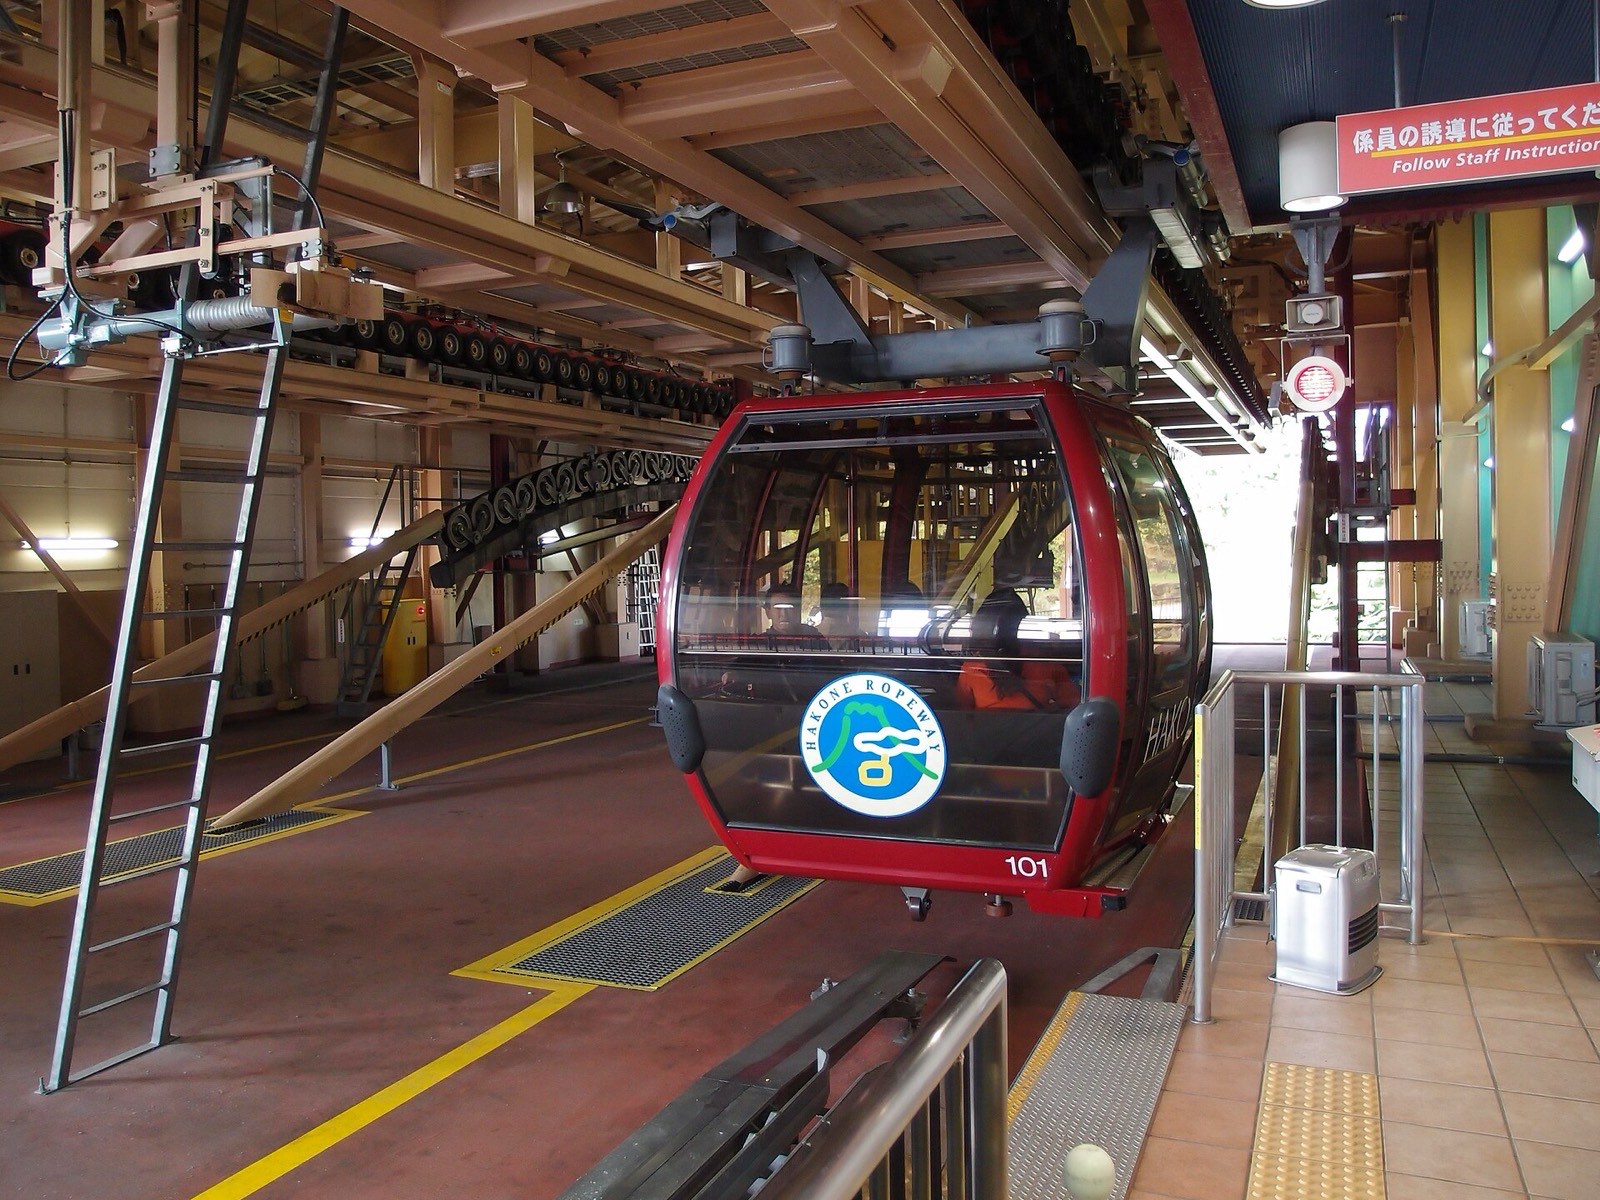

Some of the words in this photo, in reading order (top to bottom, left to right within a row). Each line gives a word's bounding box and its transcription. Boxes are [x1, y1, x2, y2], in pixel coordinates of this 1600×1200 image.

[1352, 101, 1600, 154] 係員の誘導に従ってくだ
[1392, 157, 1451, 173] Follow
[1456, 148, 1501, 166] Staff
[805, 681, 853, 751] HAKONE
[865, 679, 941, 752] ROPEWAY
[1005, 855, 1048, 878] 101
